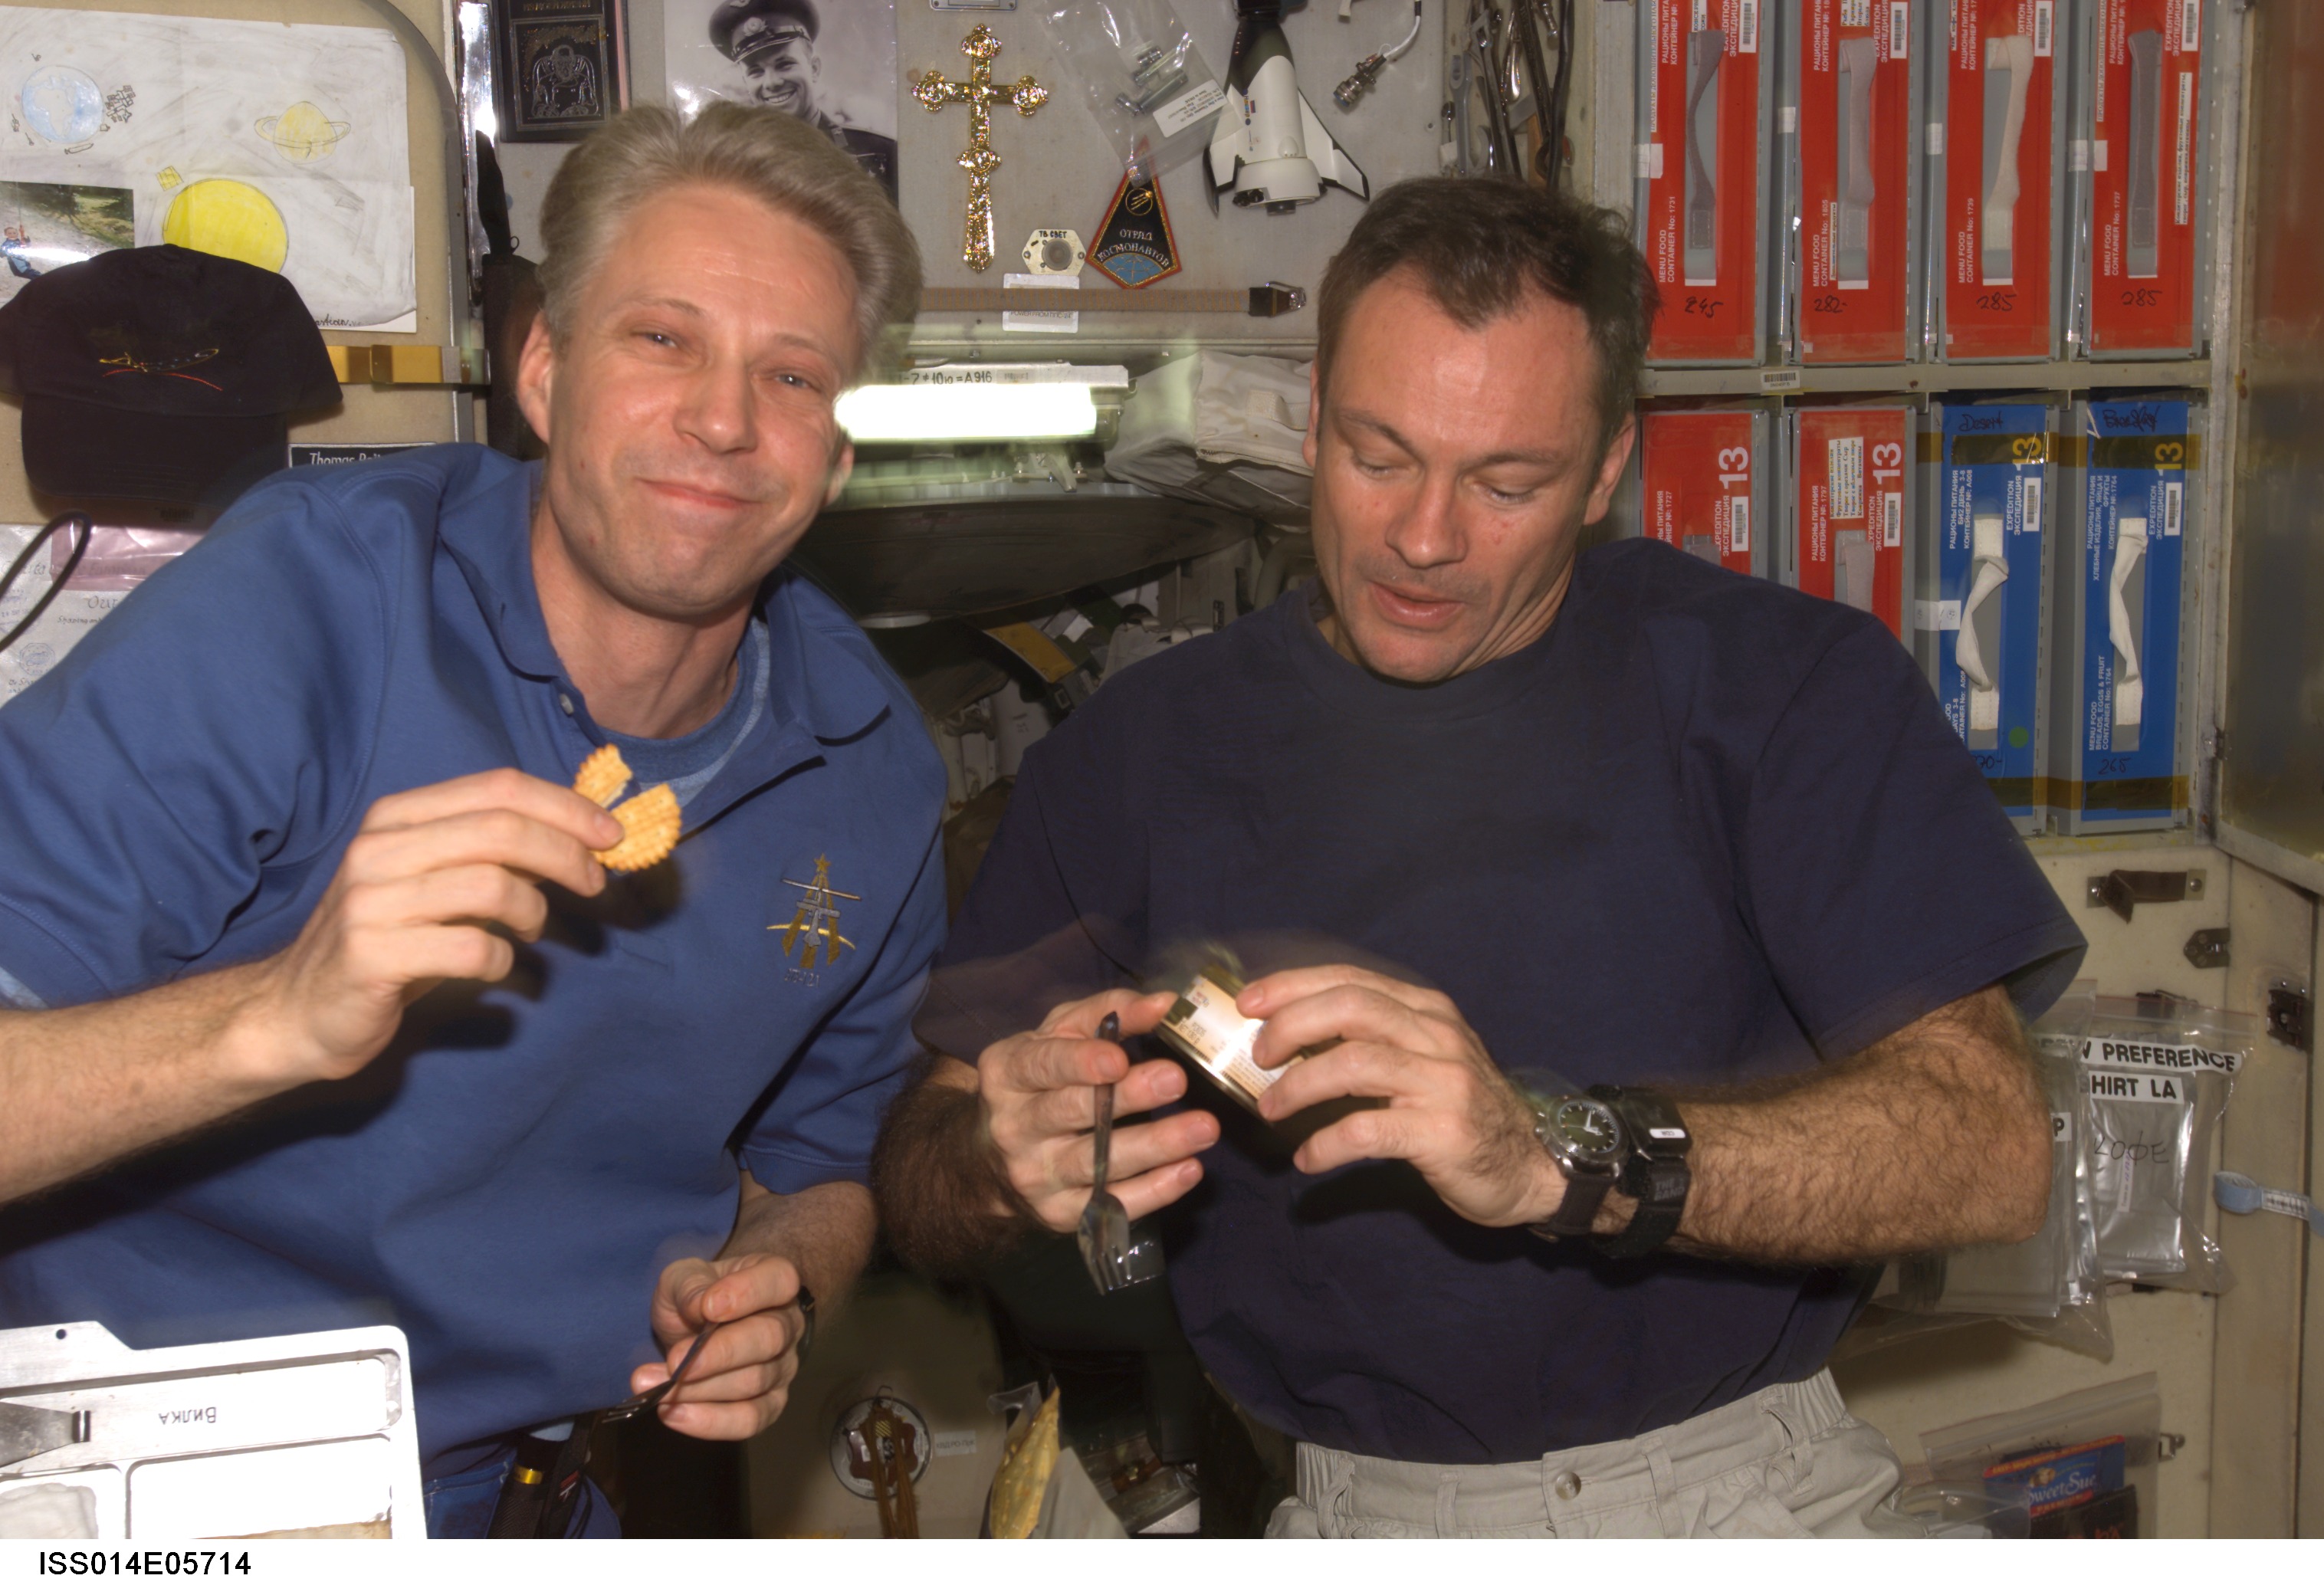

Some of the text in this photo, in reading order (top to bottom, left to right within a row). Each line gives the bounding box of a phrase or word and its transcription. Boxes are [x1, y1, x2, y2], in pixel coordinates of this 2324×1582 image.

[2109, 24, 2117, 64] РАЦИОНЫ
[1120, 229, 1153, 241] ОТРЯД
[1097, 243, 1170, 267] КОСМОНАВТОВ
[1976, 292, 2017, 311] 285
[2121, 289, 2162, 307] 285
[1718, 446, 1748, 556] ЭКСПЕДИЦИЯ 13
[1873, 442, 1902, 551] ЭКСПЕДИЦИЯ 13
[2012, 437, 2042, 535] ЭКСПЕДИЦИЯ 13
[2155, 442, 2183, 540] ЭКСПЕДИЦИЯ 13
[2006, 481, 2014, 530] EXPEDITION
[2148, 485, 2157, 535] EXPEDITION
[2096, 689, 2105, 712] EGGS
[2096, 714, 2104, 750] BREADS,
[2102, 703, 2111, 750] CONTAINER
[2102, 1042, 2234, 1072] PREFERENCE
[2091, 1075, 2177, 1099] HIRT LA
